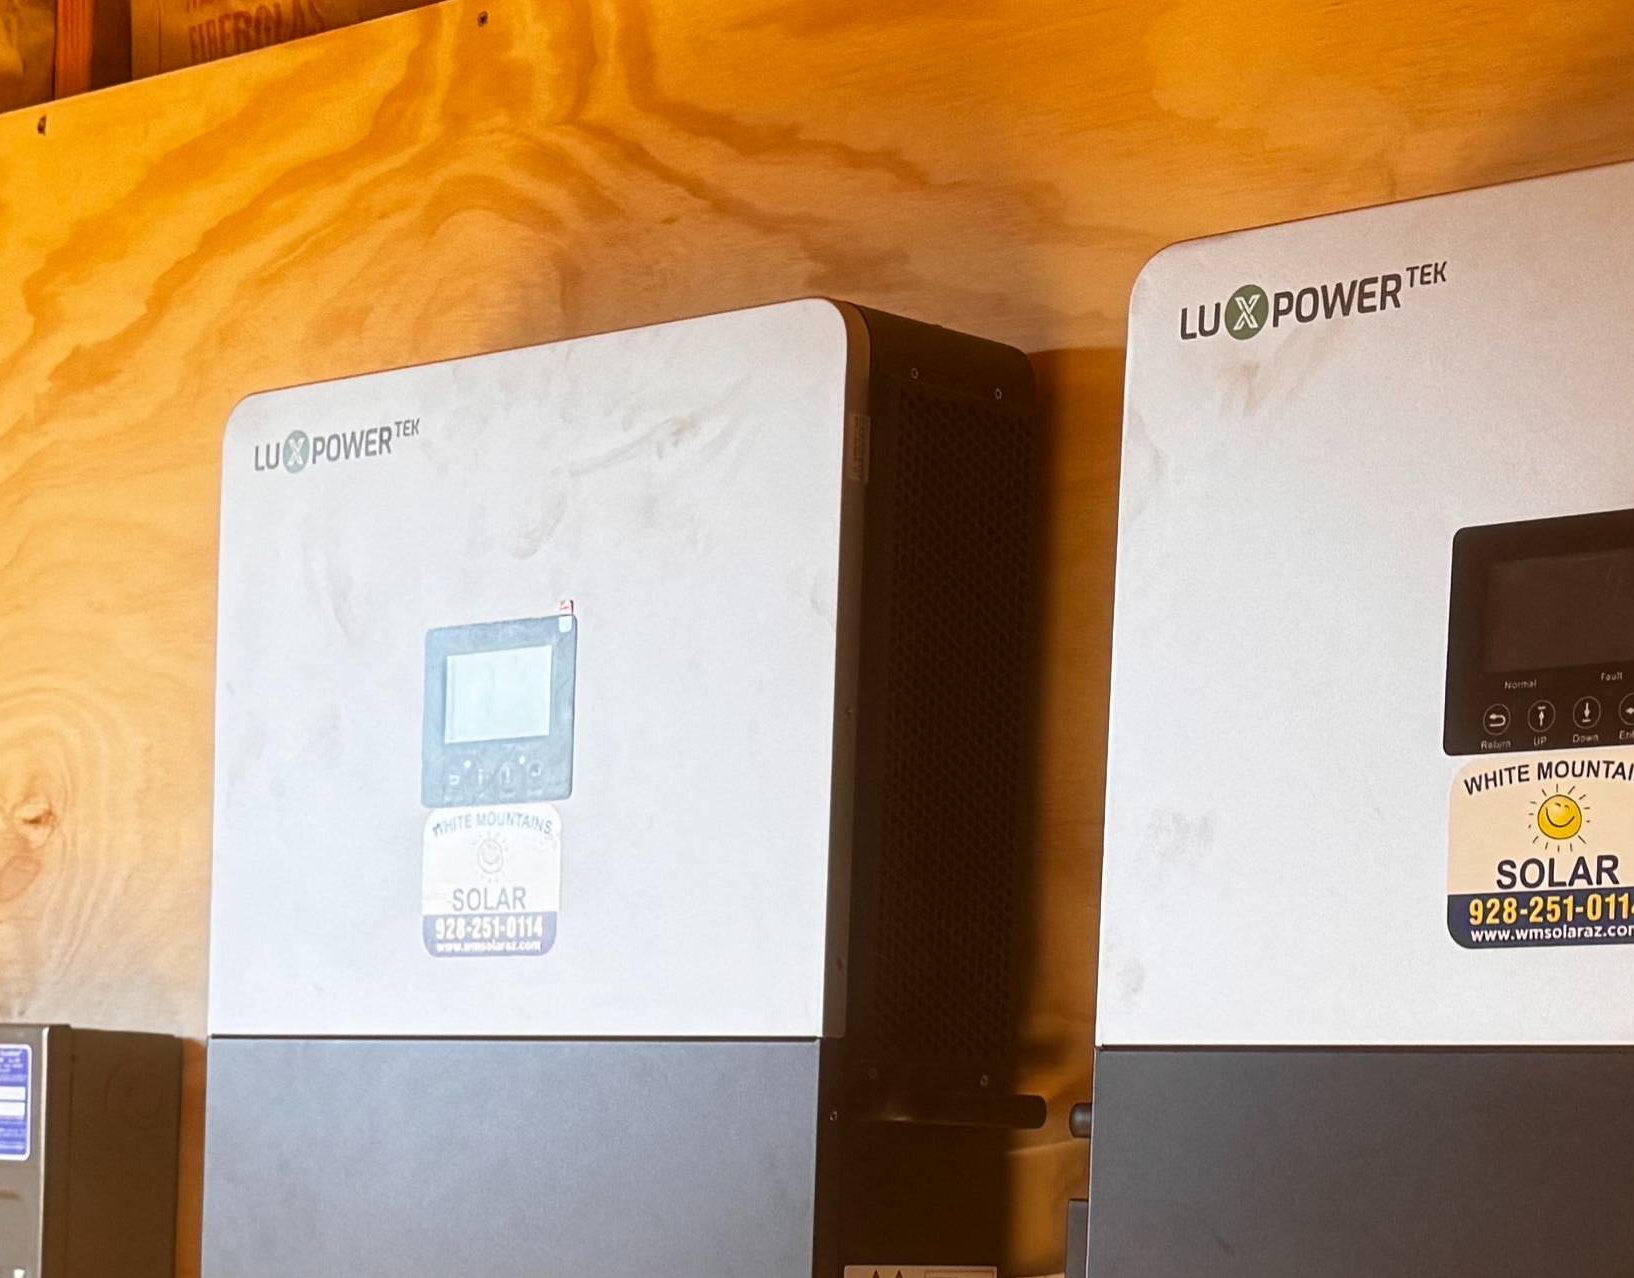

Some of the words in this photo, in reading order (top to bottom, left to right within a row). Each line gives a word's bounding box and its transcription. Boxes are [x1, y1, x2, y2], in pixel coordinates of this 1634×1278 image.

[1405, 260, 1448, 289] TEK
[393, 416, 421, 439] TEK
[1504, 679, 1538, 690] Normal
[1600, 671, 1623, 682] Fault
[1480, 739, 1512, 750] Return
[1532, 735, 1548, 746] UP
[1572, 732, 1599, 744] Down
[1463, 762, 1532, 796] WHITE
[432, 814, 474, 837] WHITE
[475, 812, 553, 836] MOUNTAINS
[1495, 853, 1621, 890] SOLAR
[451, 886, 527, 912] SOLAR
[434, 915, 544, 940] 928-251-0114
[435, 937, 542, 953] www.wmsolaraz.com
